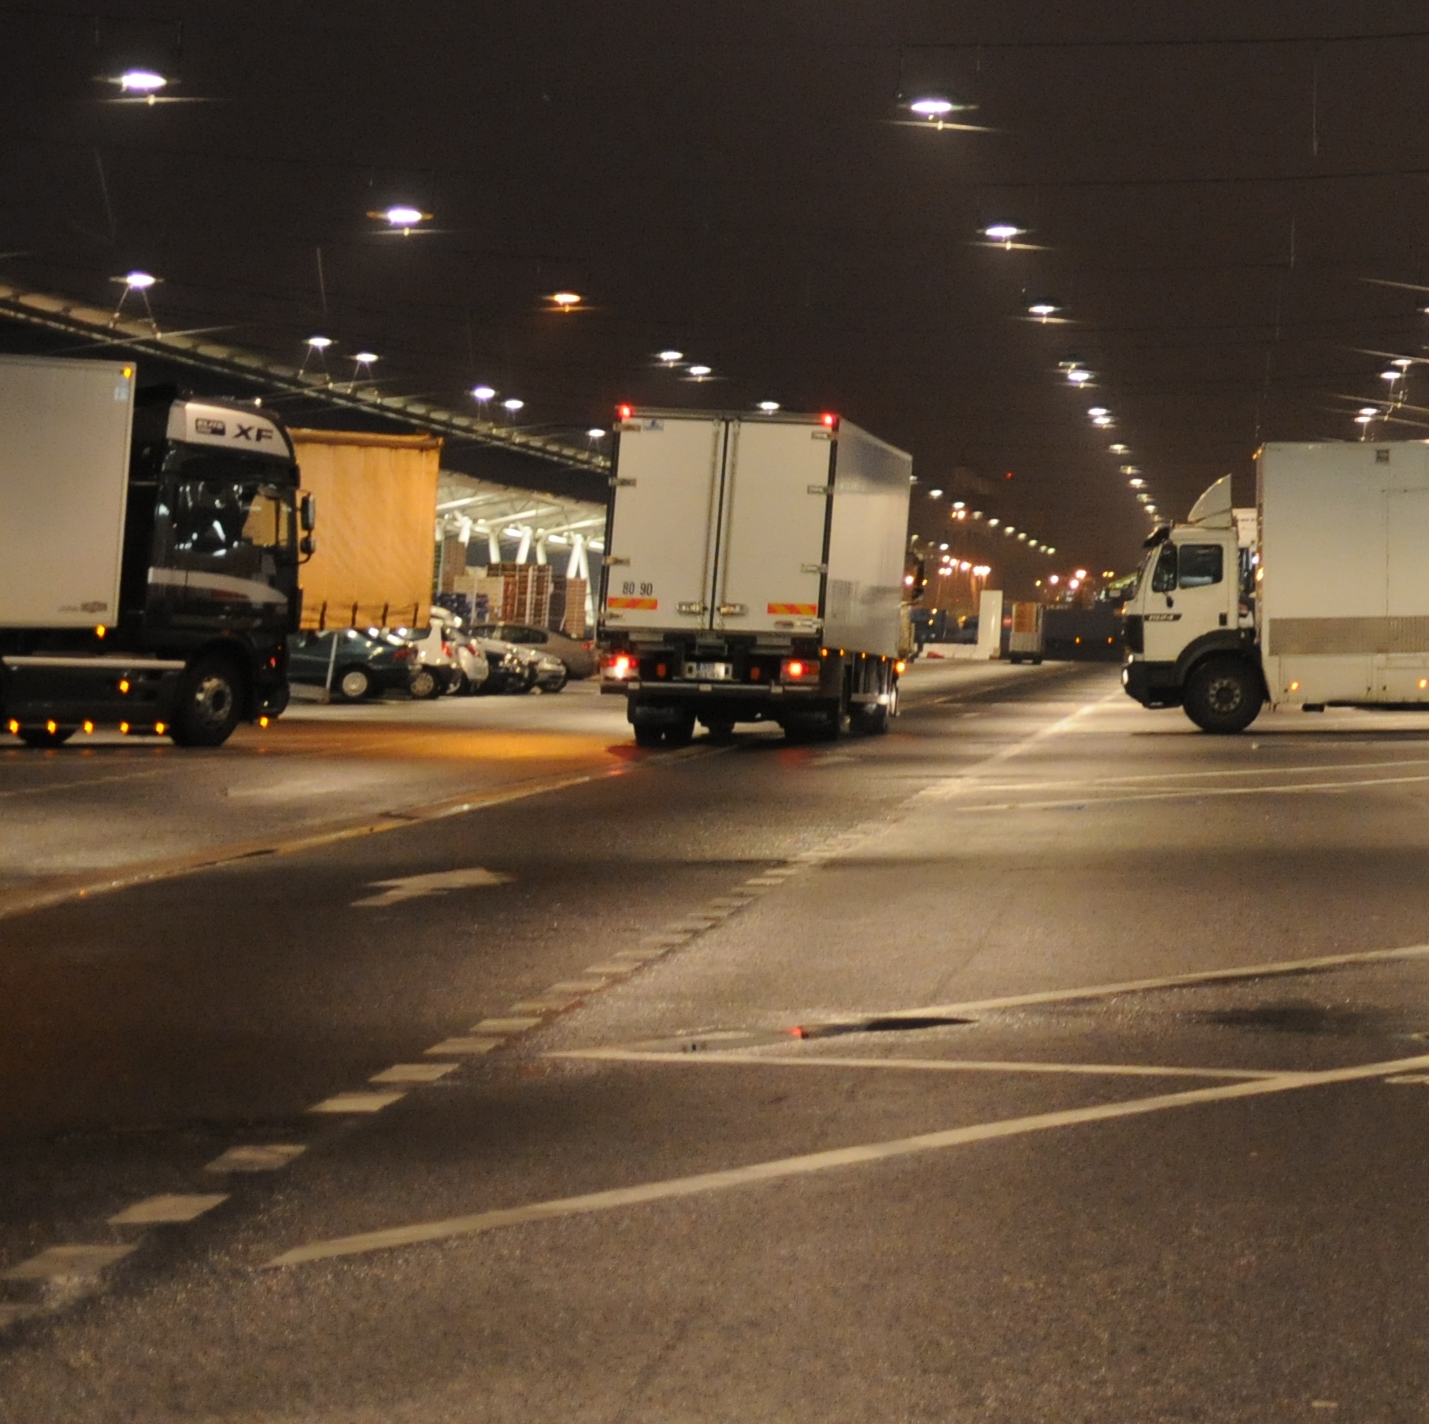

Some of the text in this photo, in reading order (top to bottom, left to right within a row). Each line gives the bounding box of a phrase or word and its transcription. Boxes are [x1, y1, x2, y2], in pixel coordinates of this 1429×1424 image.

[233, 423, 274, 442] XF
[622, 581, 653, 596] 80 90
